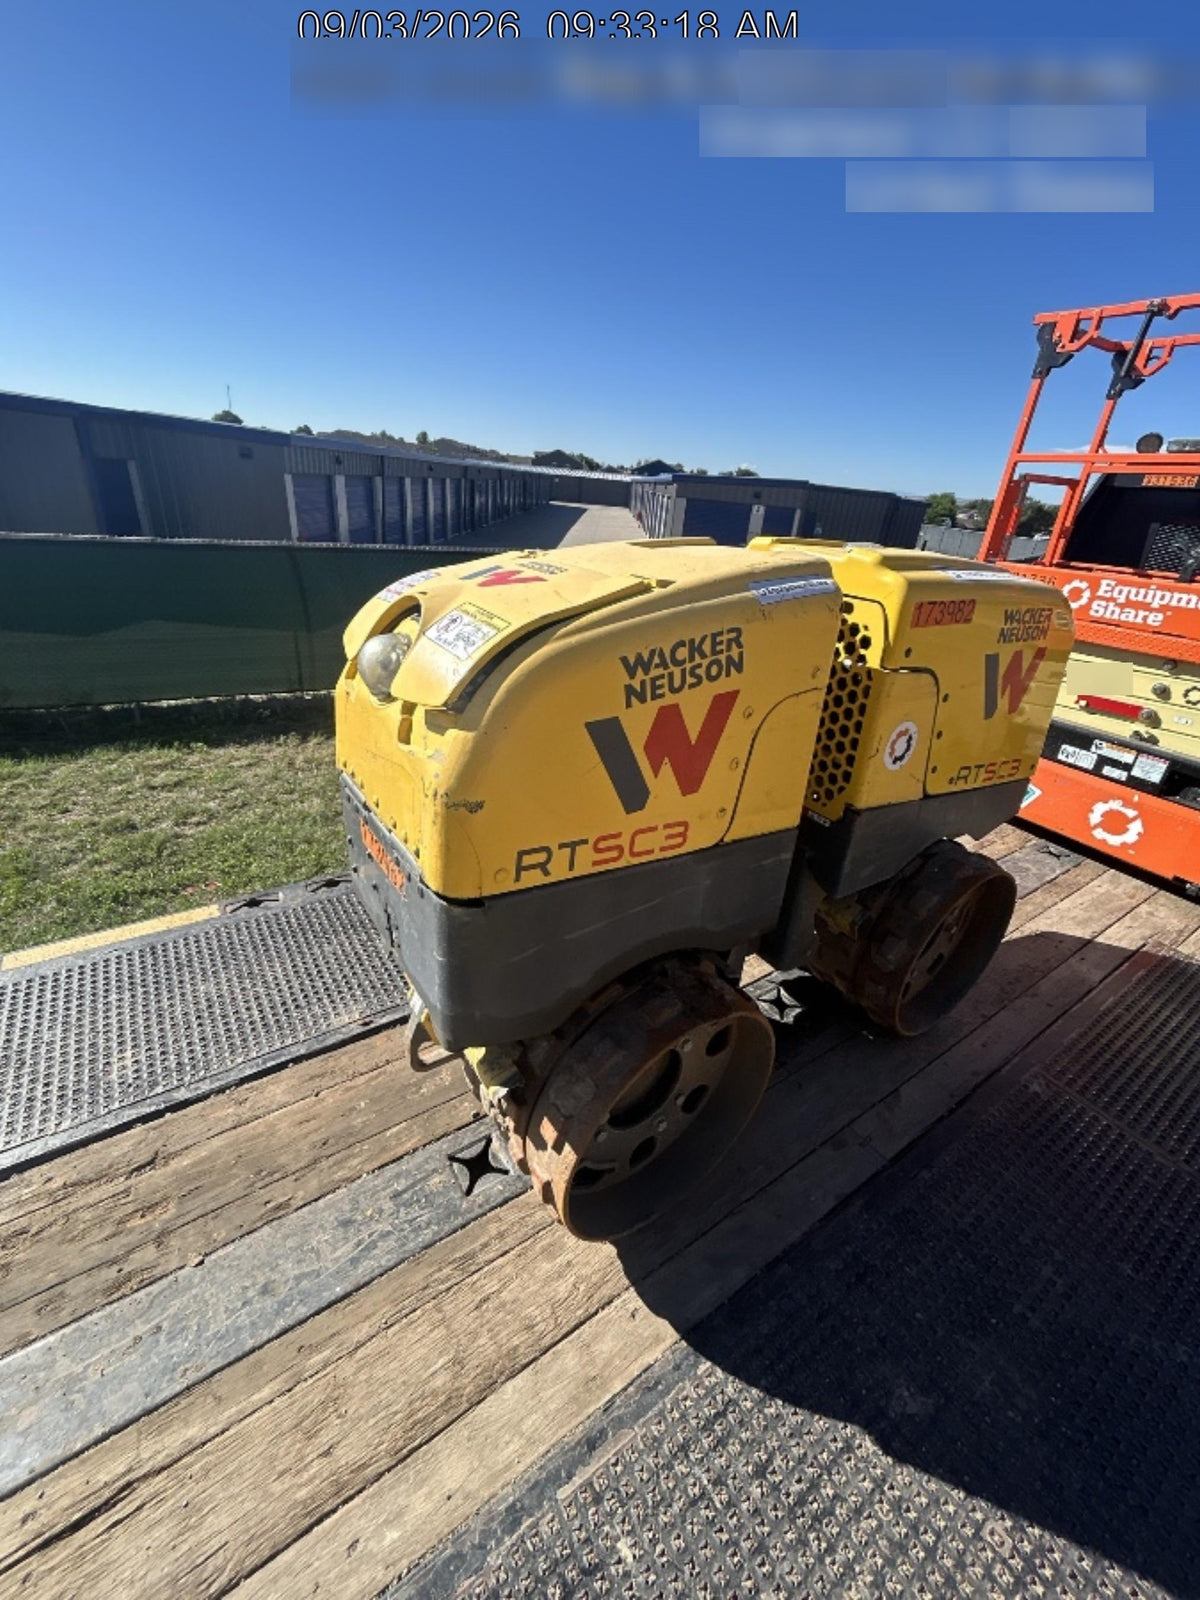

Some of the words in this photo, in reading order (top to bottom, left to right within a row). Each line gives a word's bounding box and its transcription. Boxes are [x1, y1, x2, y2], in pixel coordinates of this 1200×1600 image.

[913, 599, 975, 627] 173982
[1003, 607, 1053, 626] WACKER
[1089, 599, 1164, 626] Share
[997, 624, 1050, 644] NEUSON
[619, 627, 744, 680] WACKER
[624, 650, 744, 709] NEUSON
[955, 758, 1021, 785] RTSC3
[514, 820, 689, 883] RTSC3
